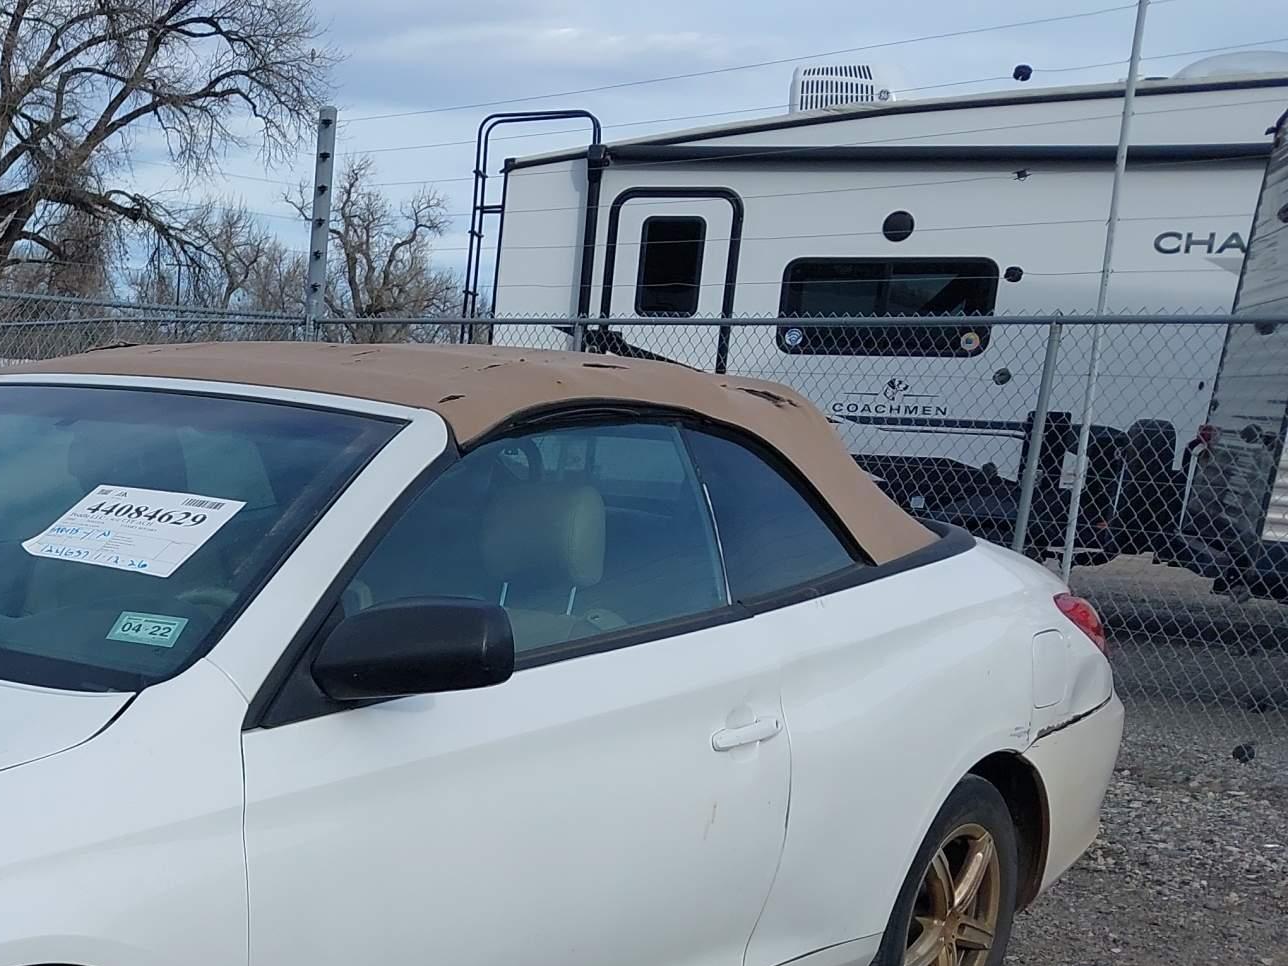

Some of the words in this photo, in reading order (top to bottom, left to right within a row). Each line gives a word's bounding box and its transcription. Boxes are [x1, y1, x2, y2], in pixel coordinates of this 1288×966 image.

[831, 402, 948, 417] COACHMEN
[86, 500, 208, 528] 44084629
[121, 622, 143, 633] 04
[148, 625, 172, 637] 22
